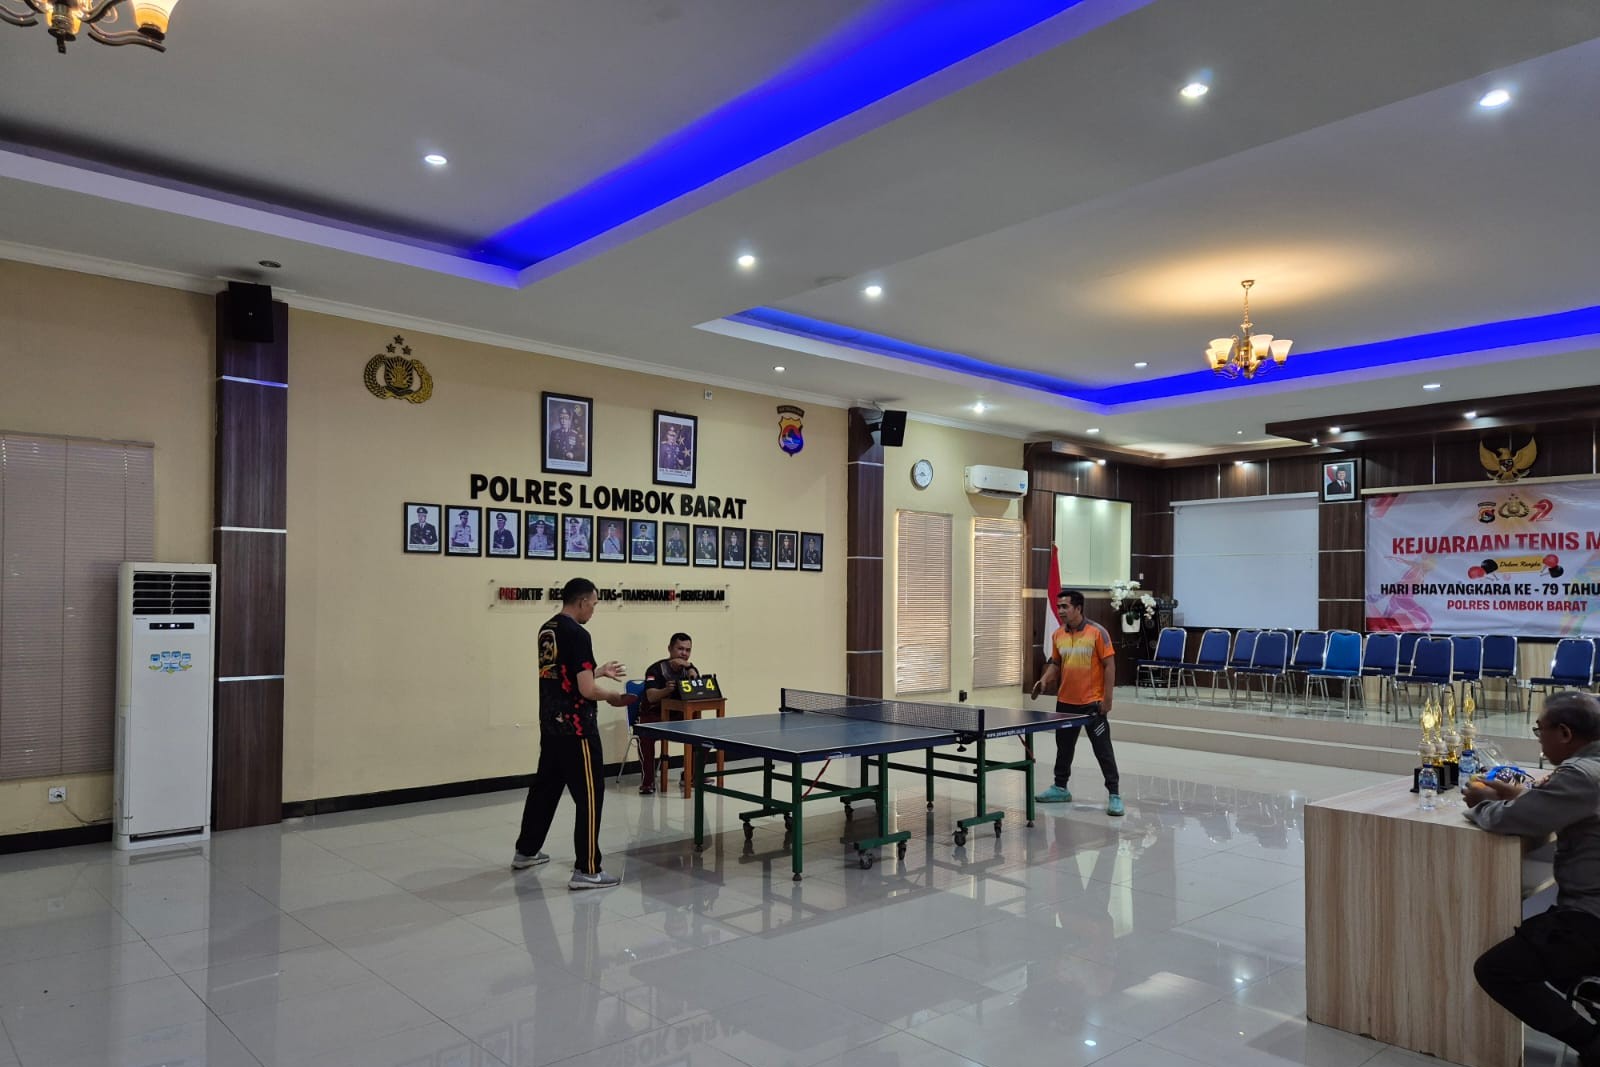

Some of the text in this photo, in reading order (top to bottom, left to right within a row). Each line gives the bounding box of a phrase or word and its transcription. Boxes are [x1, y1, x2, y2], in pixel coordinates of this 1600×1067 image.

[470, 474, 747, 519] POLRES LOMBOK BARAT
[1392, 534, 1509, 554] KEJUARAAN
[1515, 532, 1579, 551] TENIS
[1381, 584, 1408, 595] HARI
[1412, 583, 1511, 595] BHAYANGKARA
[1515, 584, 1531, 595] KE
[1542, 583, 1558, 595] 79
[1447, 600, 1587, 611] POLRES LOMBOK BARAT
[681, 680, 691, 692] 5
[706, 679, 714, 690] 4
